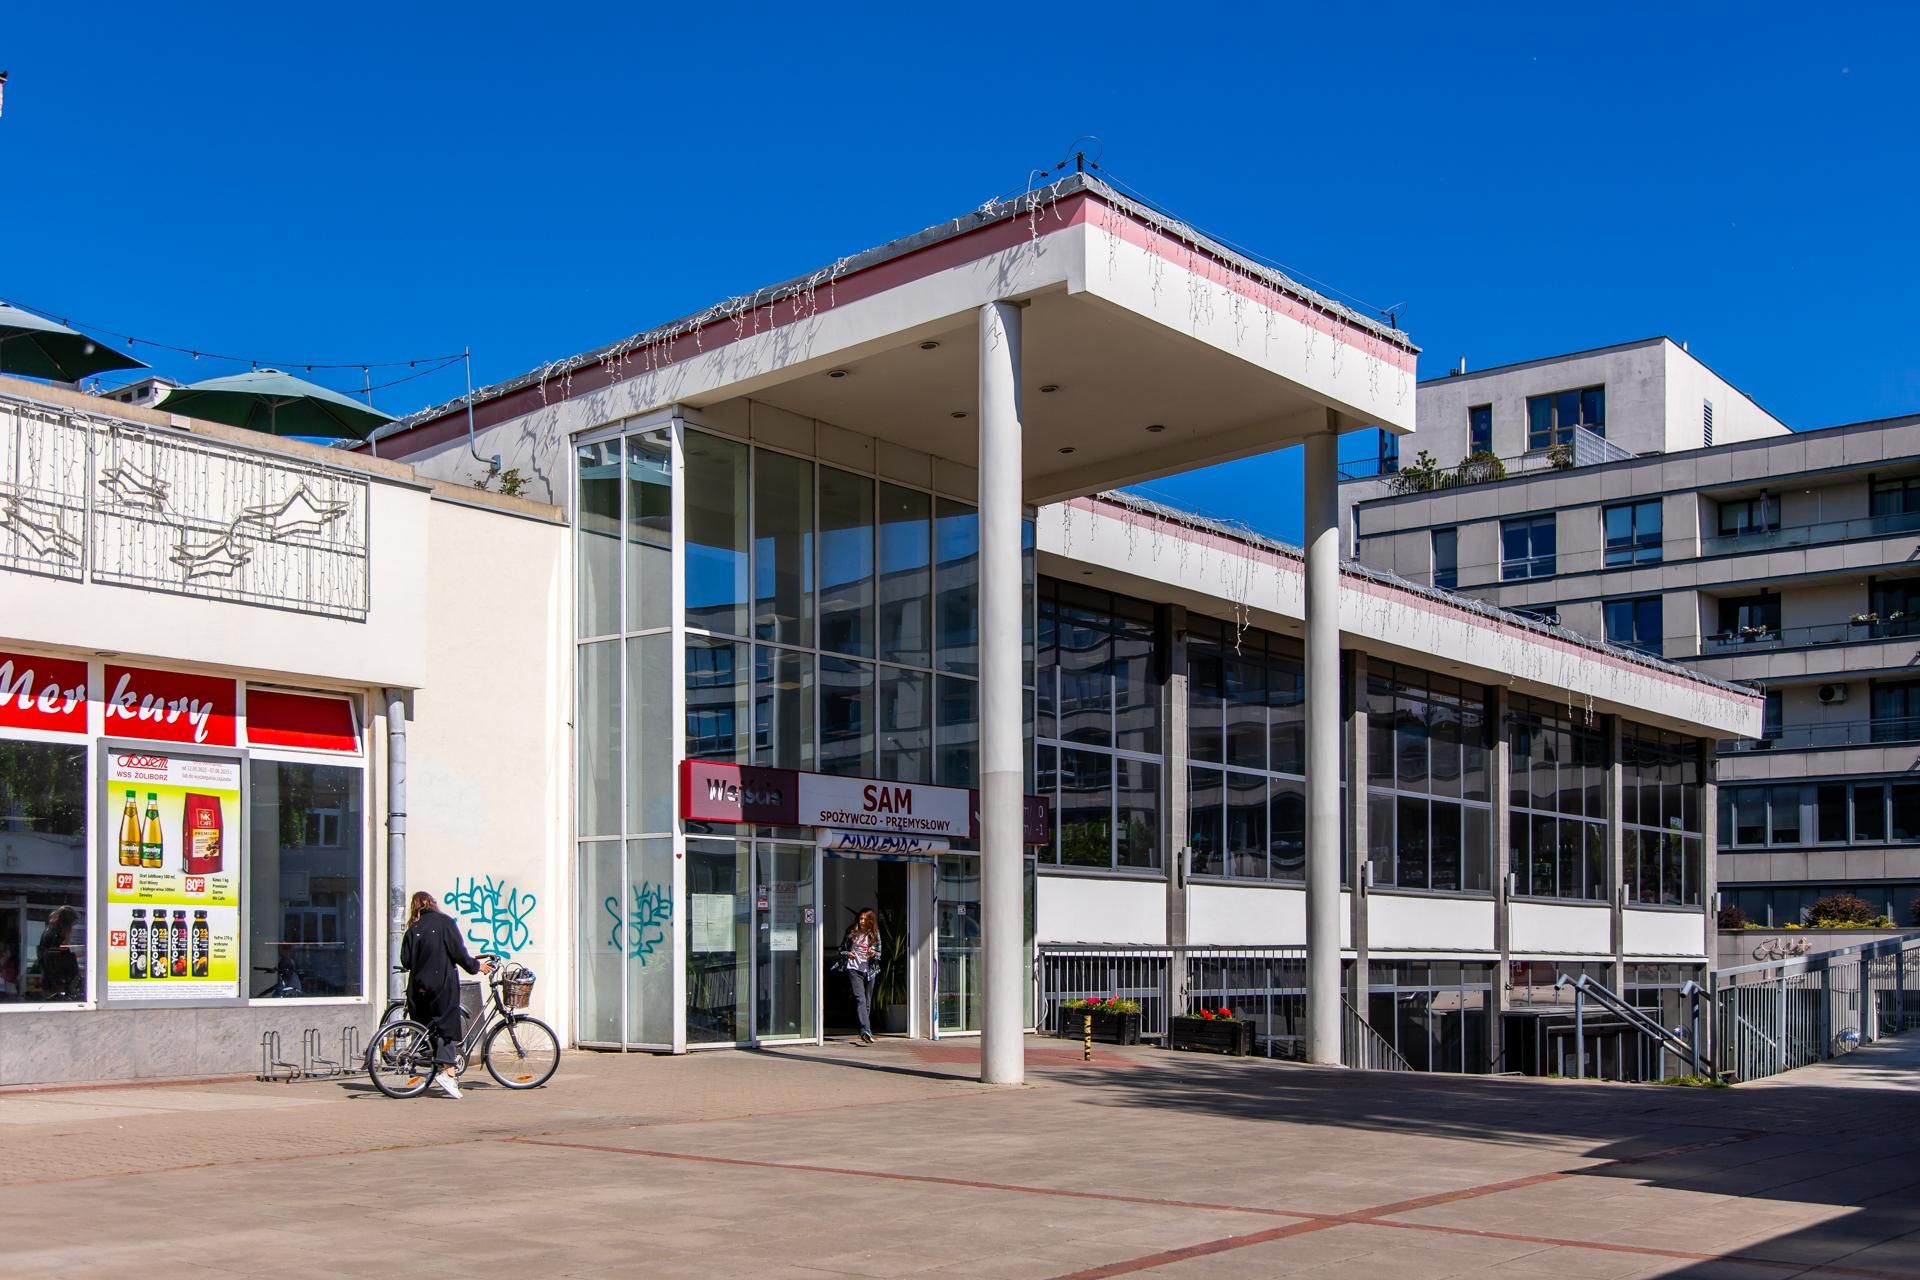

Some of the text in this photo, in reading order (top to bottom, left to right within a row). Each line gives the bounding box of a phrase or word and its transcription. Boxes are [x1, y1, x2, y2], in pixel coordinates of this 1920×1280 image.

[116, 771, 168, 781] WSS ŻOLIBORZ
[863, 785, 912, 815] SAM
[820, 809, 877, 826] SPOŻYWCZO
[886, 816, 950, 831] PRZEMYSŁOWY
